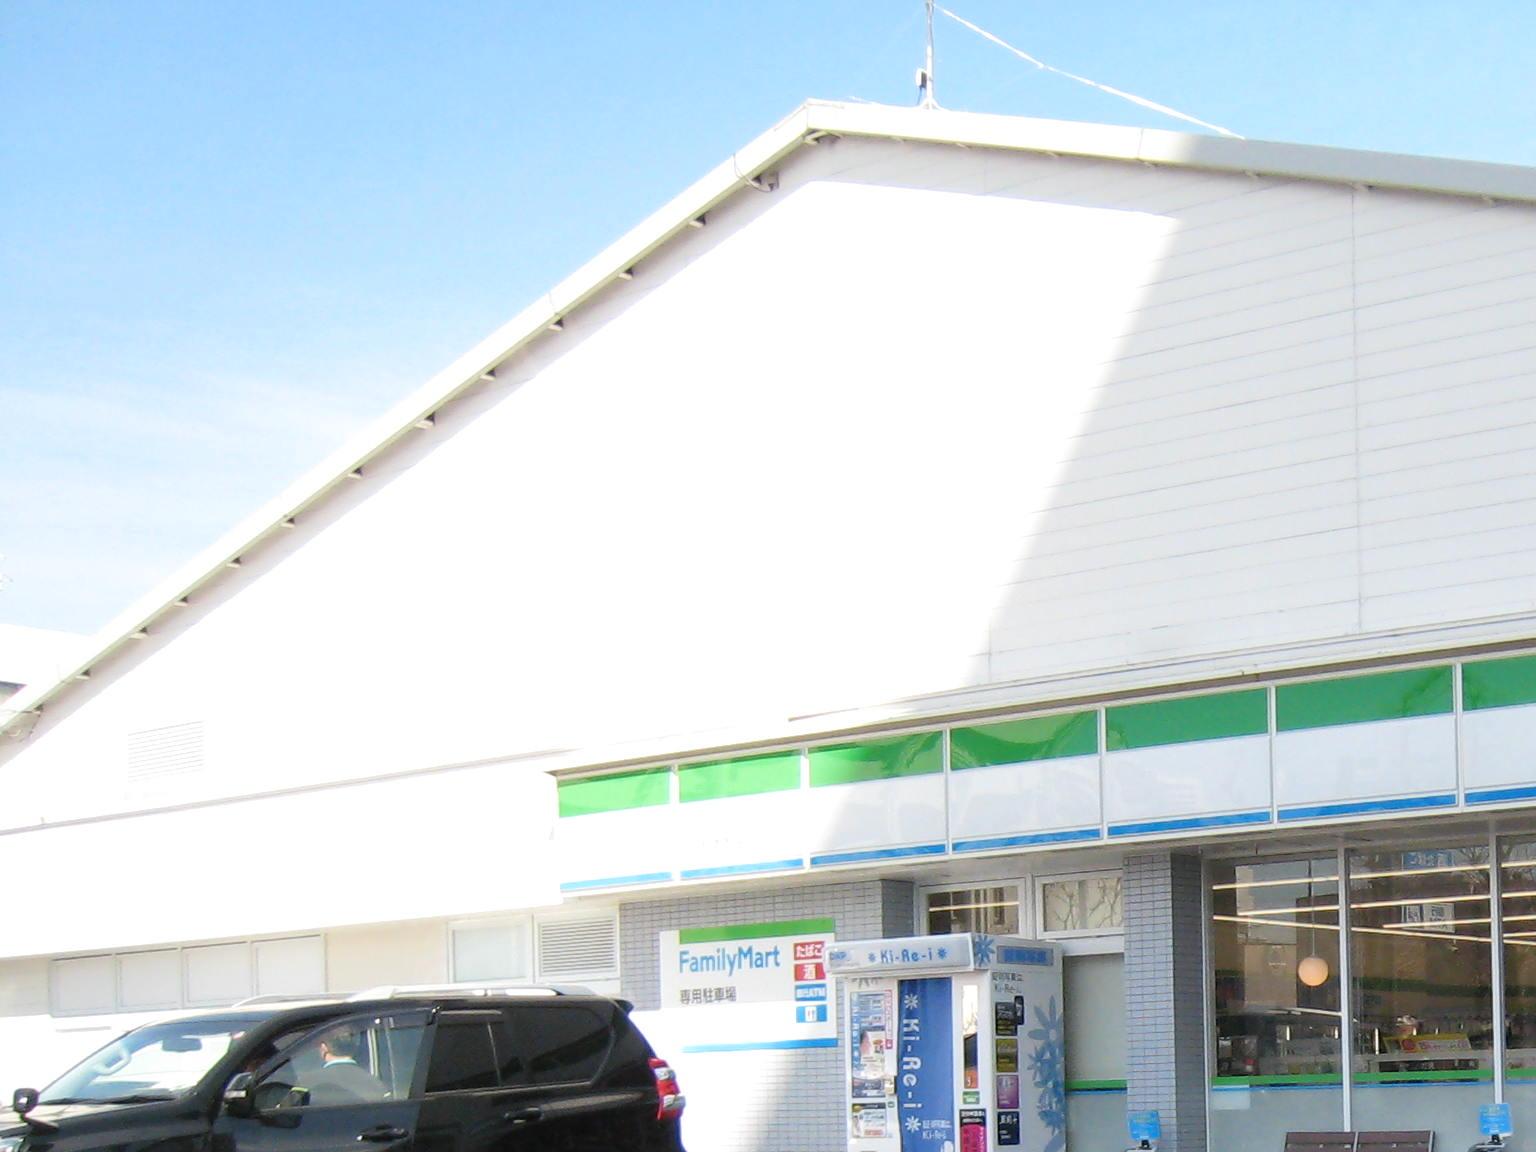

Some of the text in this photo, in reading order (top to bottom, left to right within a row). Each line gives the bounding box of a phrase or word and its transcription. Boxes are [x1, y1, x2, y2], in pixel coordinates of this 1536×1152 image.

[679, 945, 781, 976] FamilyMart
[795, 943, 825, 958] たばこ
[680, 986, 737, 1005] 専用駐車場
[903, 1018, 922, 1108] Ki-Re-i
